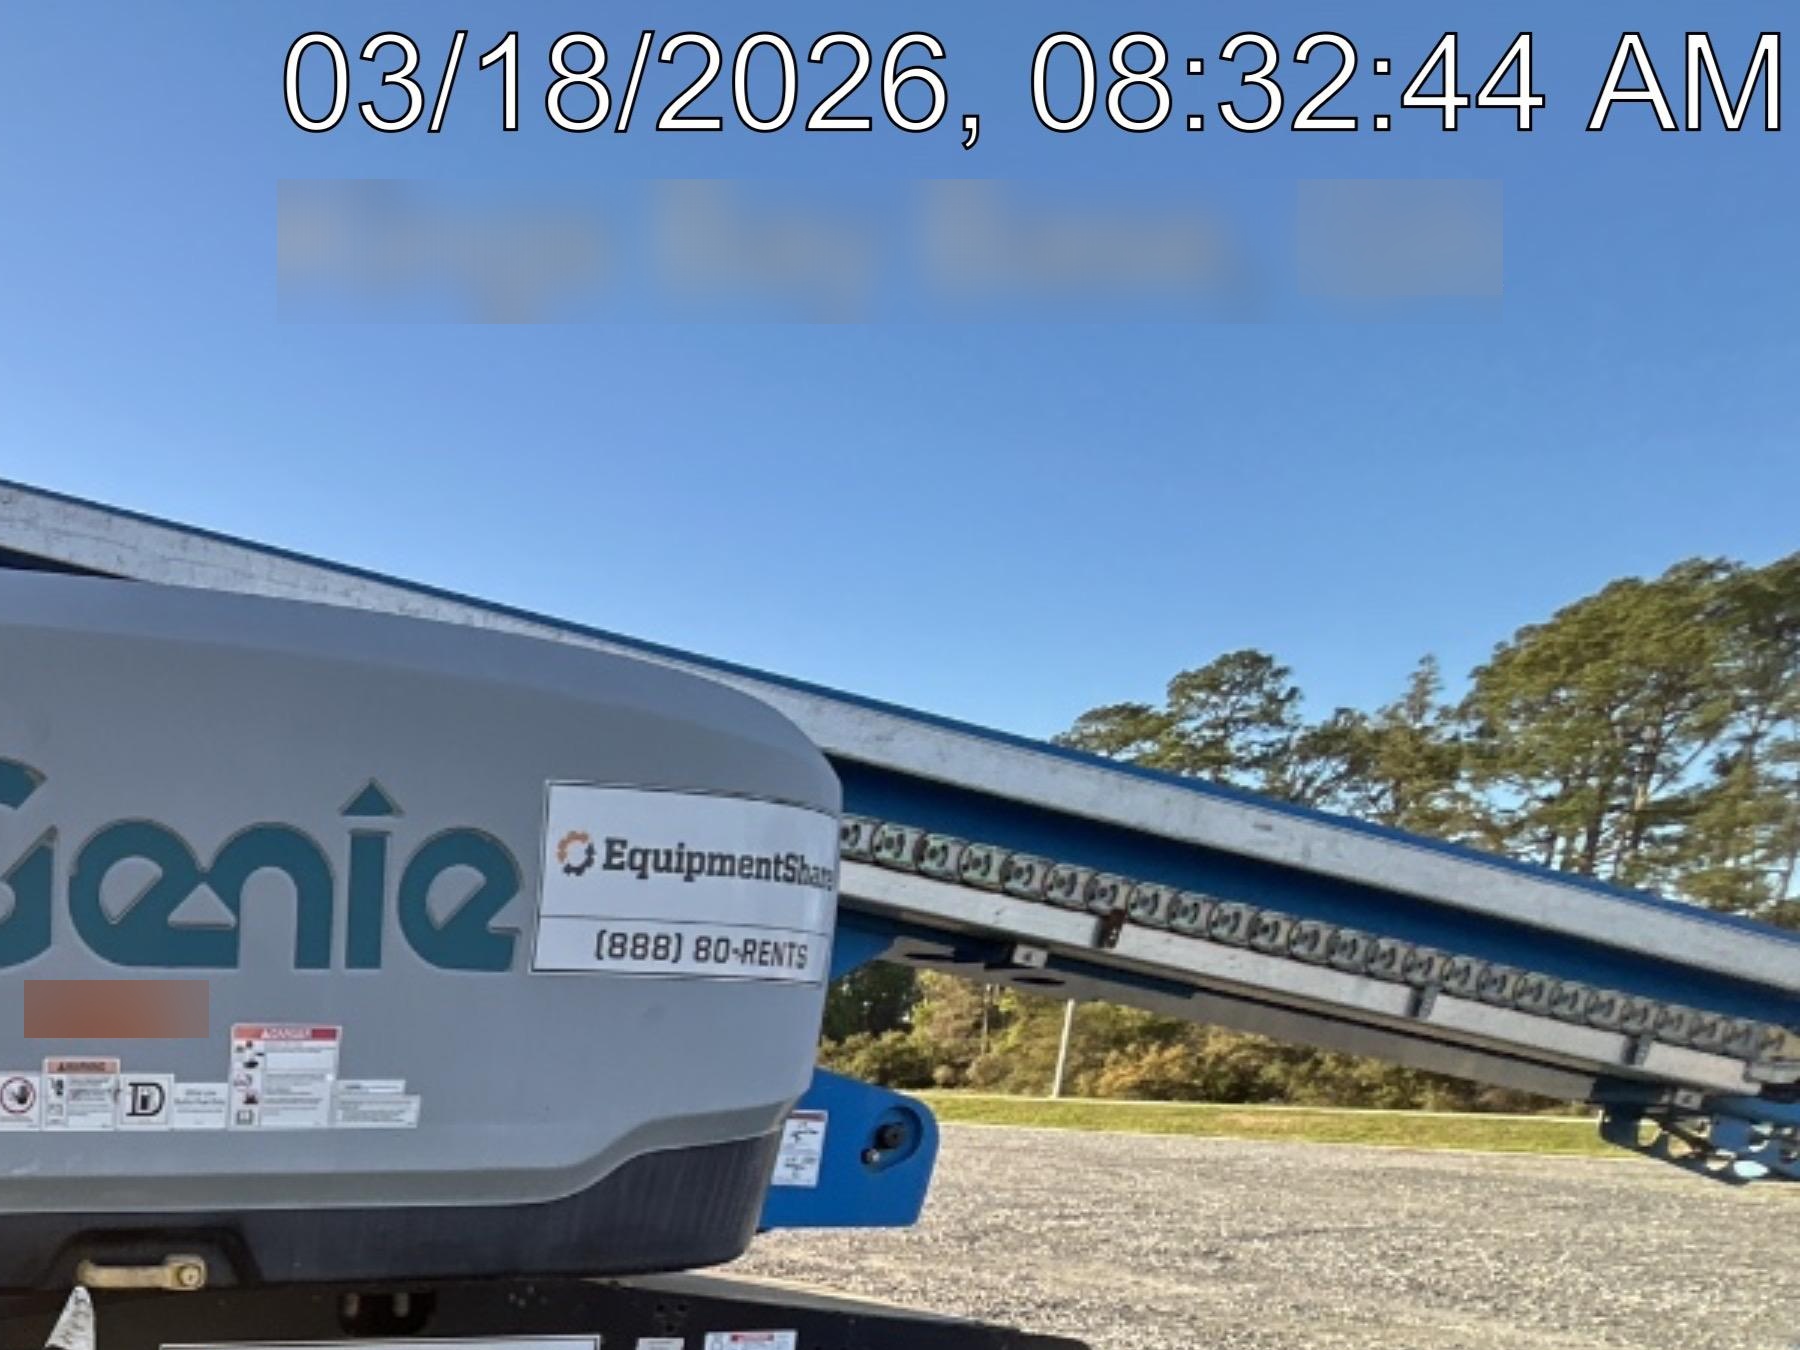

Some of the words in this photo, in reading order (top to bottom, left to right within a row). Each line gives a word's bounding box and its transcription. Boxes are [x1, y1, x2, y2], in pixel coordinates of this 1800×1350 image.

[602, 836, 834, 891] EquipmentShare
[595, 929, 682, 963] (888)
[694, 935, 809, 970] 80-RENTS
